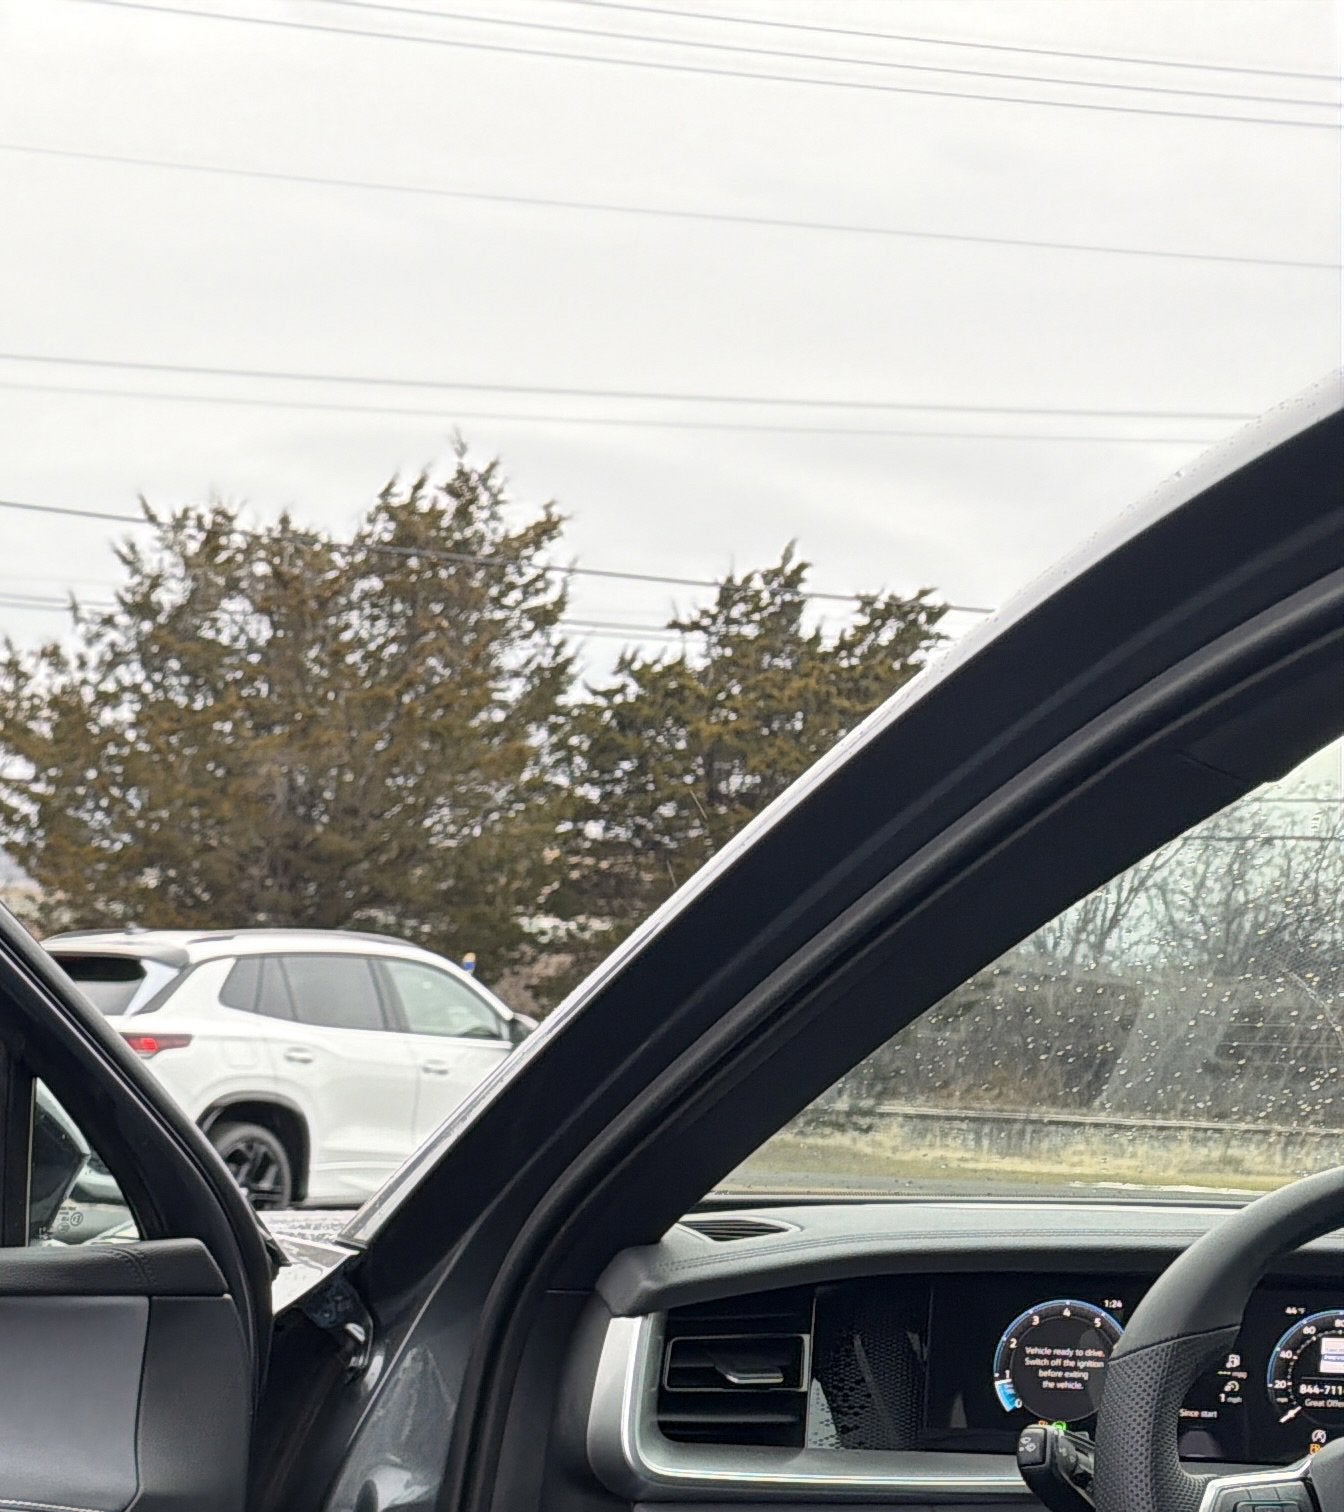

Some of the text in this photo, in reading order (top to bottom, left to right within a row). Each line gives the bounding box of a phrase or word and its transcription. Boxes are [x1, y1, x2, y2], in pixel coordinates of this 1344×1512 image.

[1063, 1308, 1071, 1317] 4
[1032, 1316, 1040, 1325] 3
[1094, 1318, 1102, 1328] 5
[1303, 1325, 1316, 1335] 60
[1009, 1338, 1017, 1348] 2
[1025, 1346, 1052, 1355] Vehicle
[1053, 1347, 1074, 1358] ready
[1075, 1349, 1084, 1357] to
[1279, 1350, 1292, 1359] 40
[1025, 1357, 1105, 1369] Switch off the ignition
[1038, 1369, 1089, 1380] before exiting
[1042, 1380, 1055, 1389] the
[1274, 1380, 1287, 1389] 20
[1015, 1399, 1022, 1408] 0
[1179, 1409, 1218, 1418] Since start
